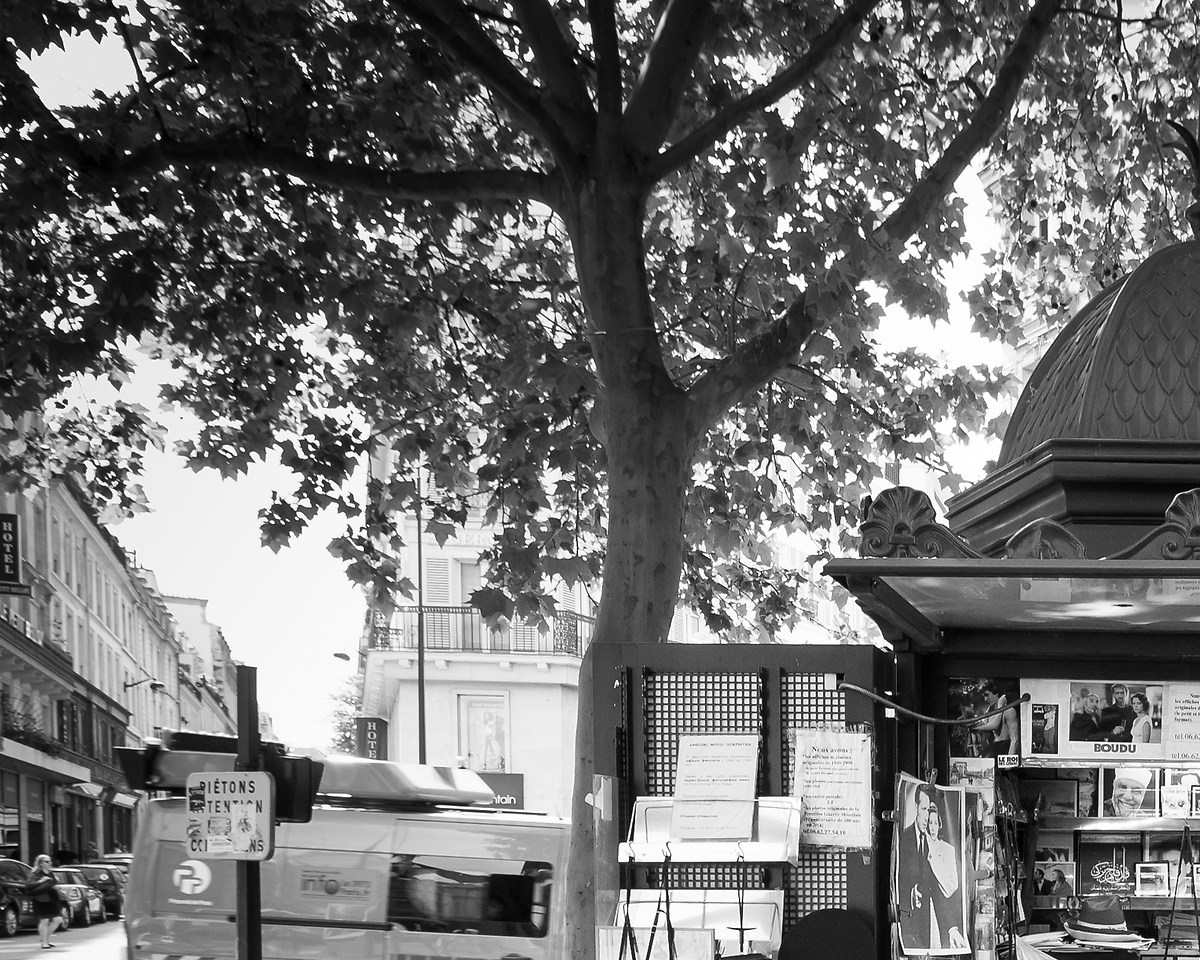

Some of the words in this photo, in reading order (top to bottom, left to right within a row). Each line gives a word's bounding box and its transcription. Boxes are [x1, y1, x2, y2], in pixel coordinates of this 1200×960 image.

[2, 522, 14, 574] HOTEL
[367, 722, 377, 759] HOTE
[1094, 744, 1136, 753] BOUDU
[200, 778, 255, 794] PIÉTONS
